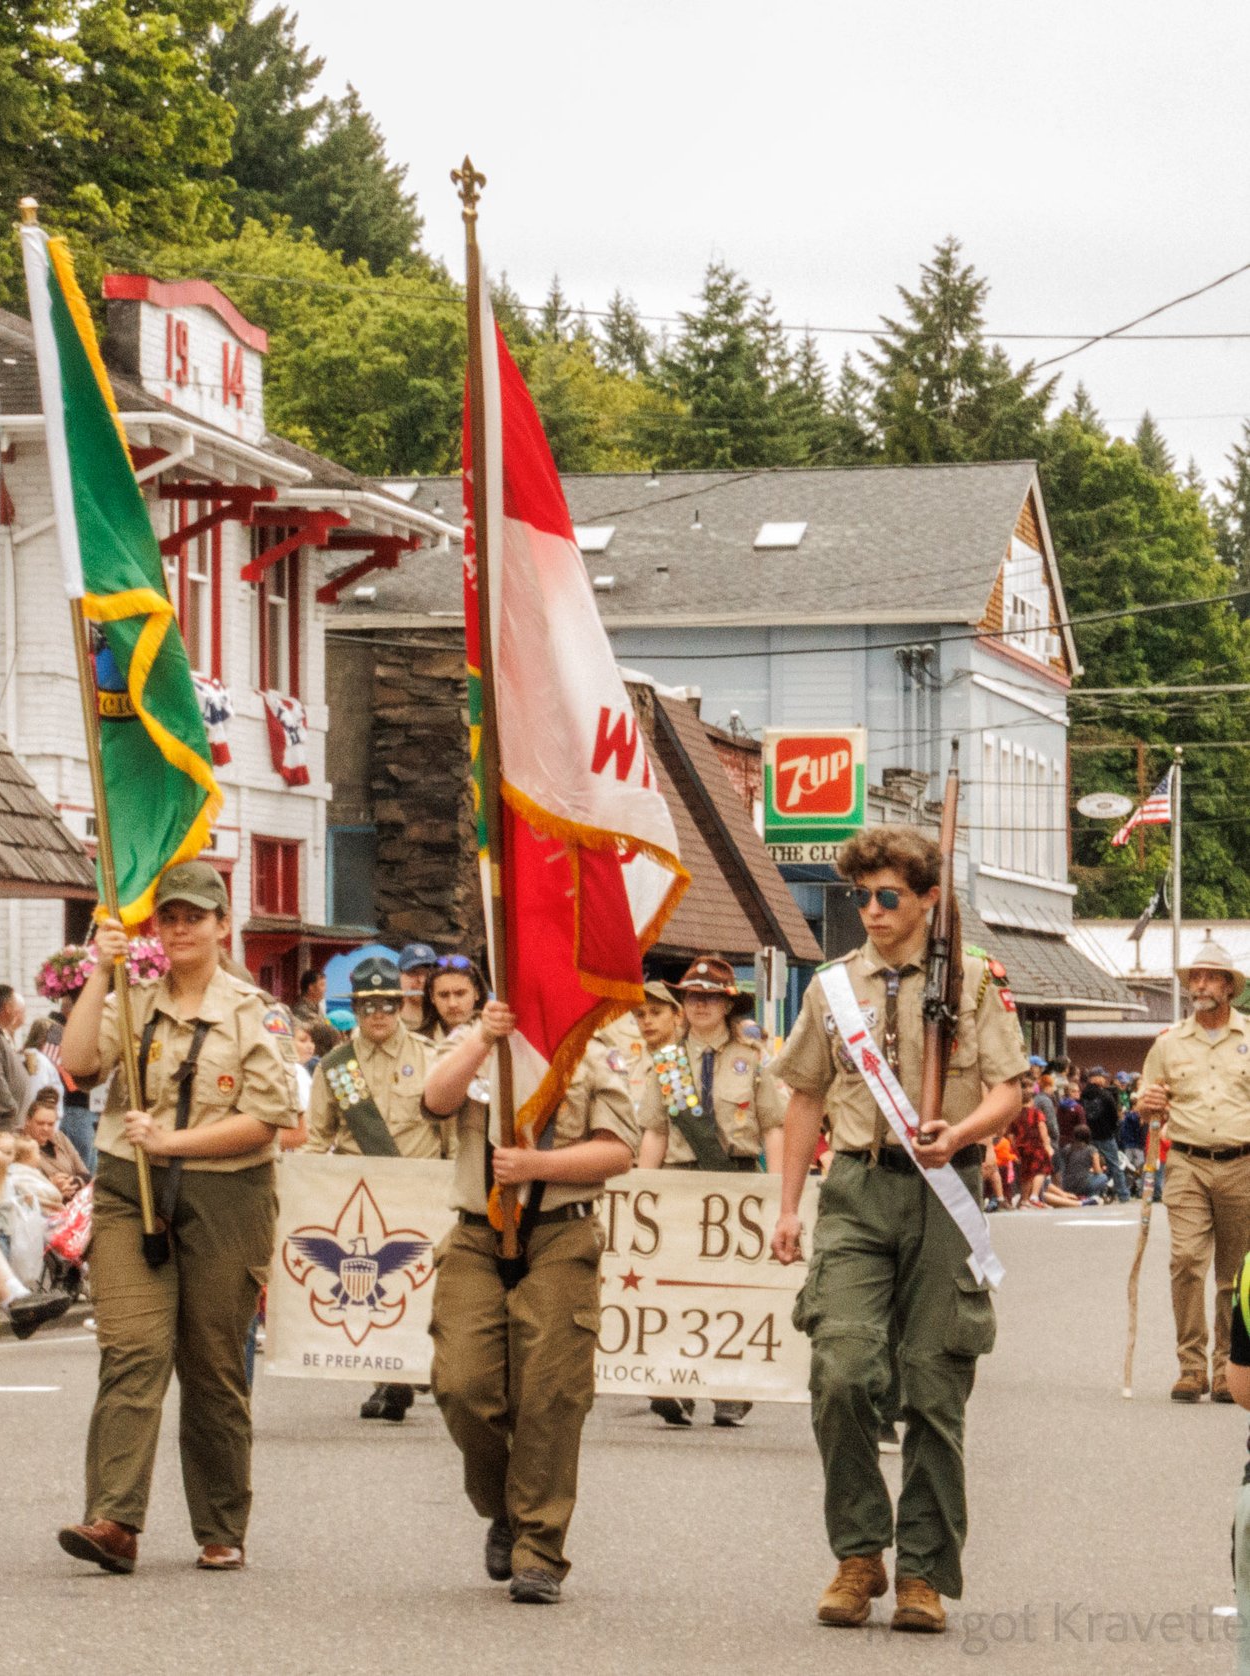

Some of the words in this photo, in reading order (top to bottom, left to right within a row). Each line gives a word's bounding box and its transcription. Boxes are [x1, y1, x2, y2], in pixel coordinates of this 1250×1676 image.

[165, 313, 188, 388] 19
[222, 341, 244, 409] 14
[768, 846, 803, 861] THE
[679, 1309, 782, 1362] 324
[303, 1353, 320, 1367] BE
[326, 1354, 403, 1370] PREPARED
[670, 1367, 707, 1385] WA.
